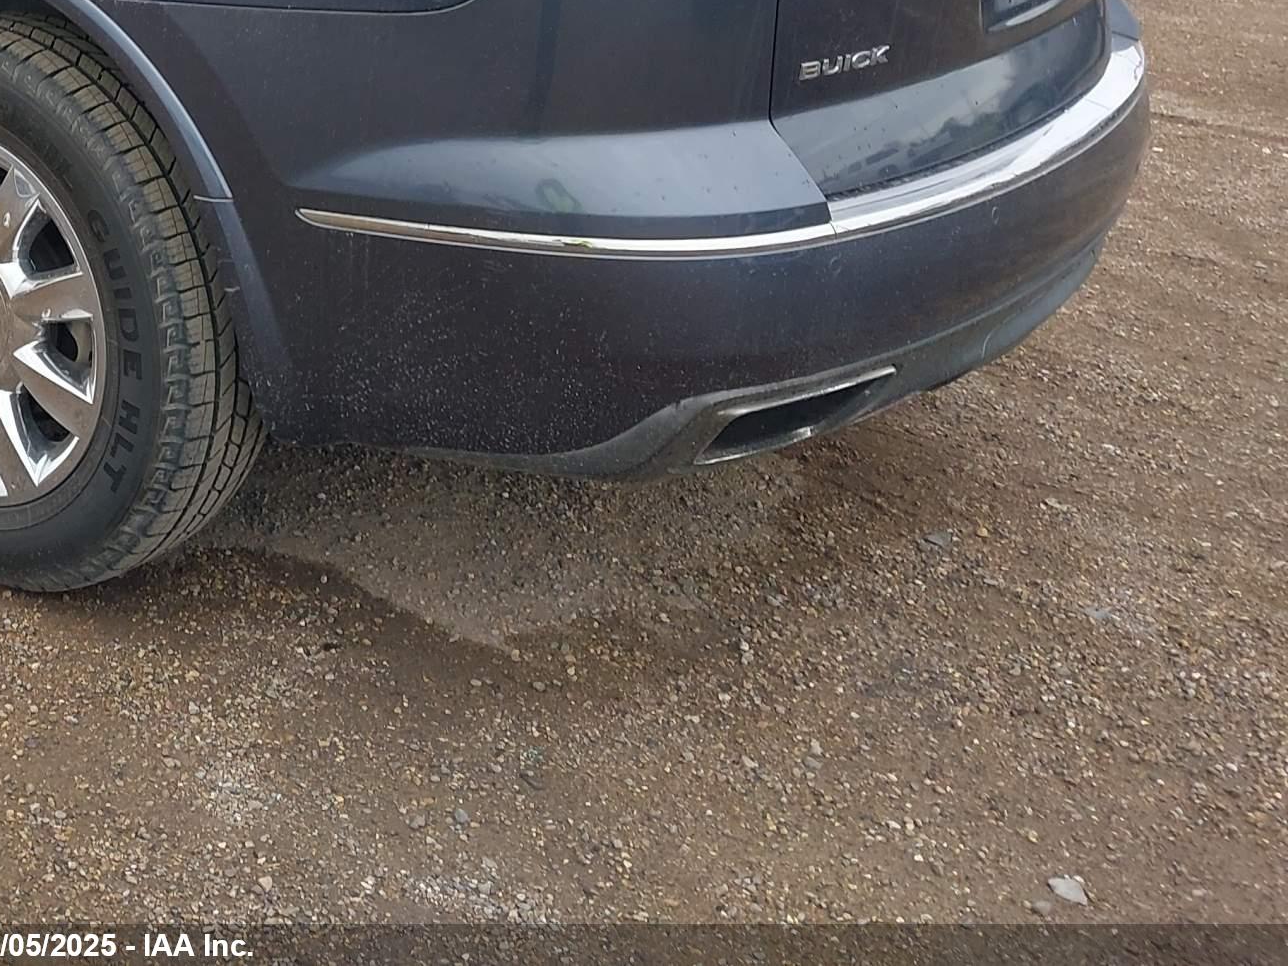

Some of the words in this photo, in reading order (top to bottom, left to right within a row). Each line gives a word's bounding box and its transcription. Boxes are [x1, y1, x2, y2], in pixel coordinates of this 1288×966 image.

[798, 44, 890, 81] BUICK
[86, 208, 143, 381] GUIDE
[102, 399, 142, 493] HLT
